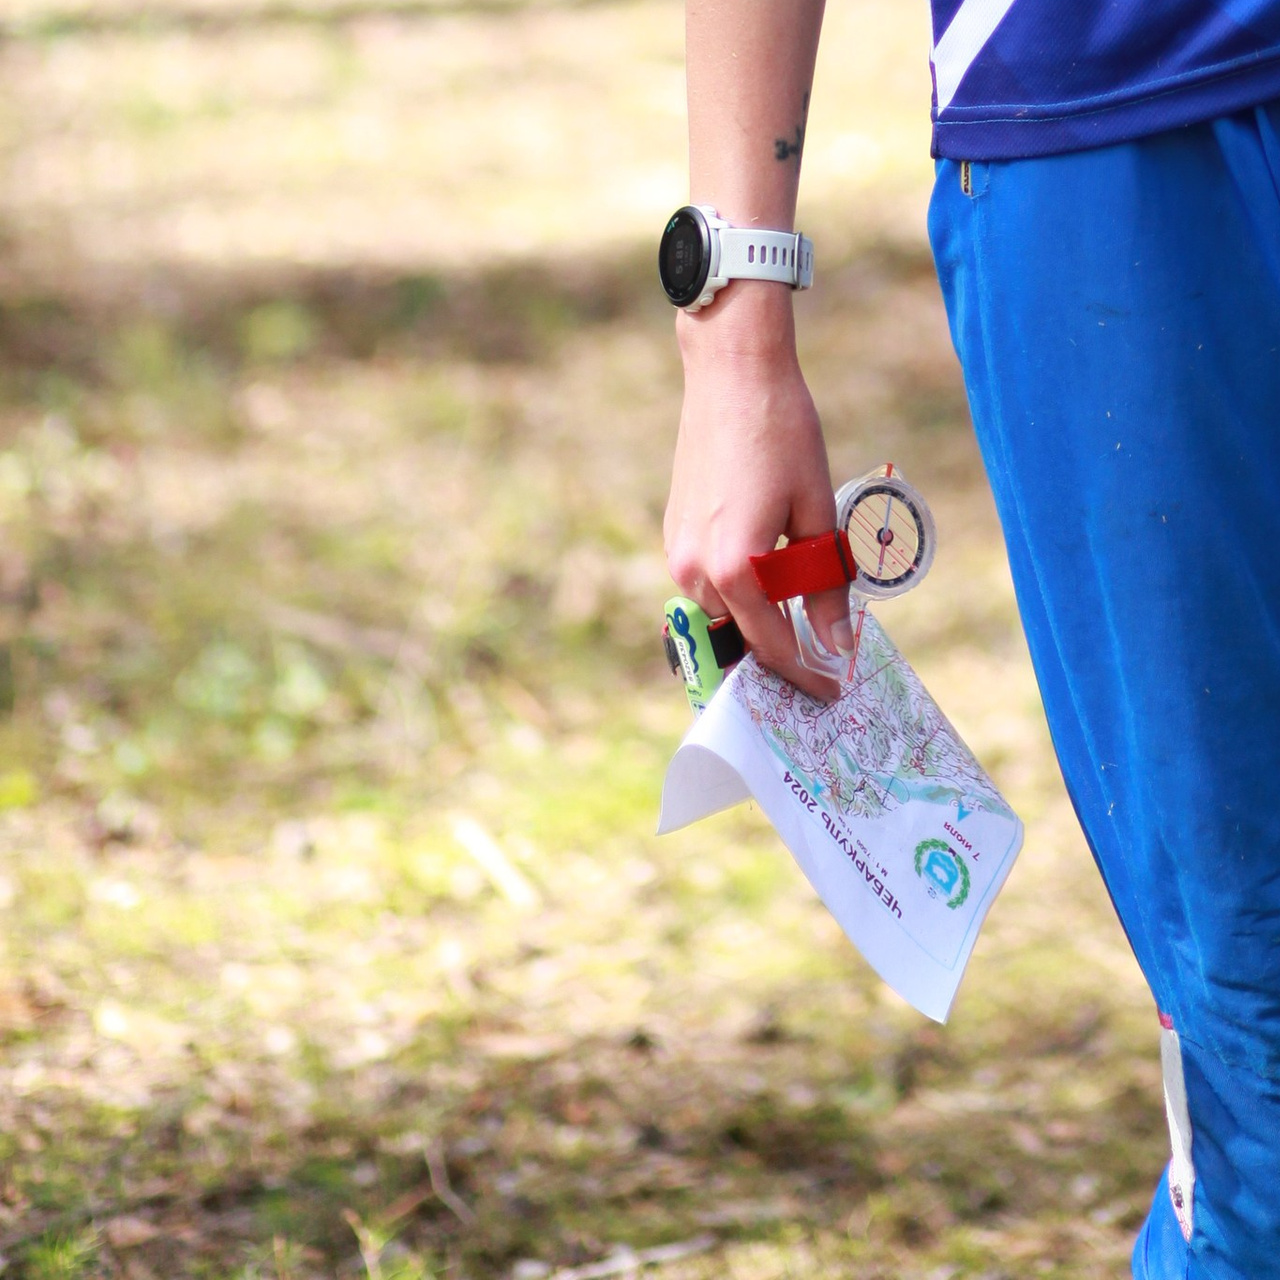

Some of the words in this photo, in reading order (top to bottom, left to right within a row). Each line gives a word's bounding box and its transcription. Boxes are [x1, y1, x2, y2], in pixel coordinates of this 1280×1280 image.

[783, 771, 818, 813] 2024
[943, 821, 973, 852] июля
[821, 811, 902, 919] ЧЕБАРКУЛЬ
[972, 851, 981, 863] 7
